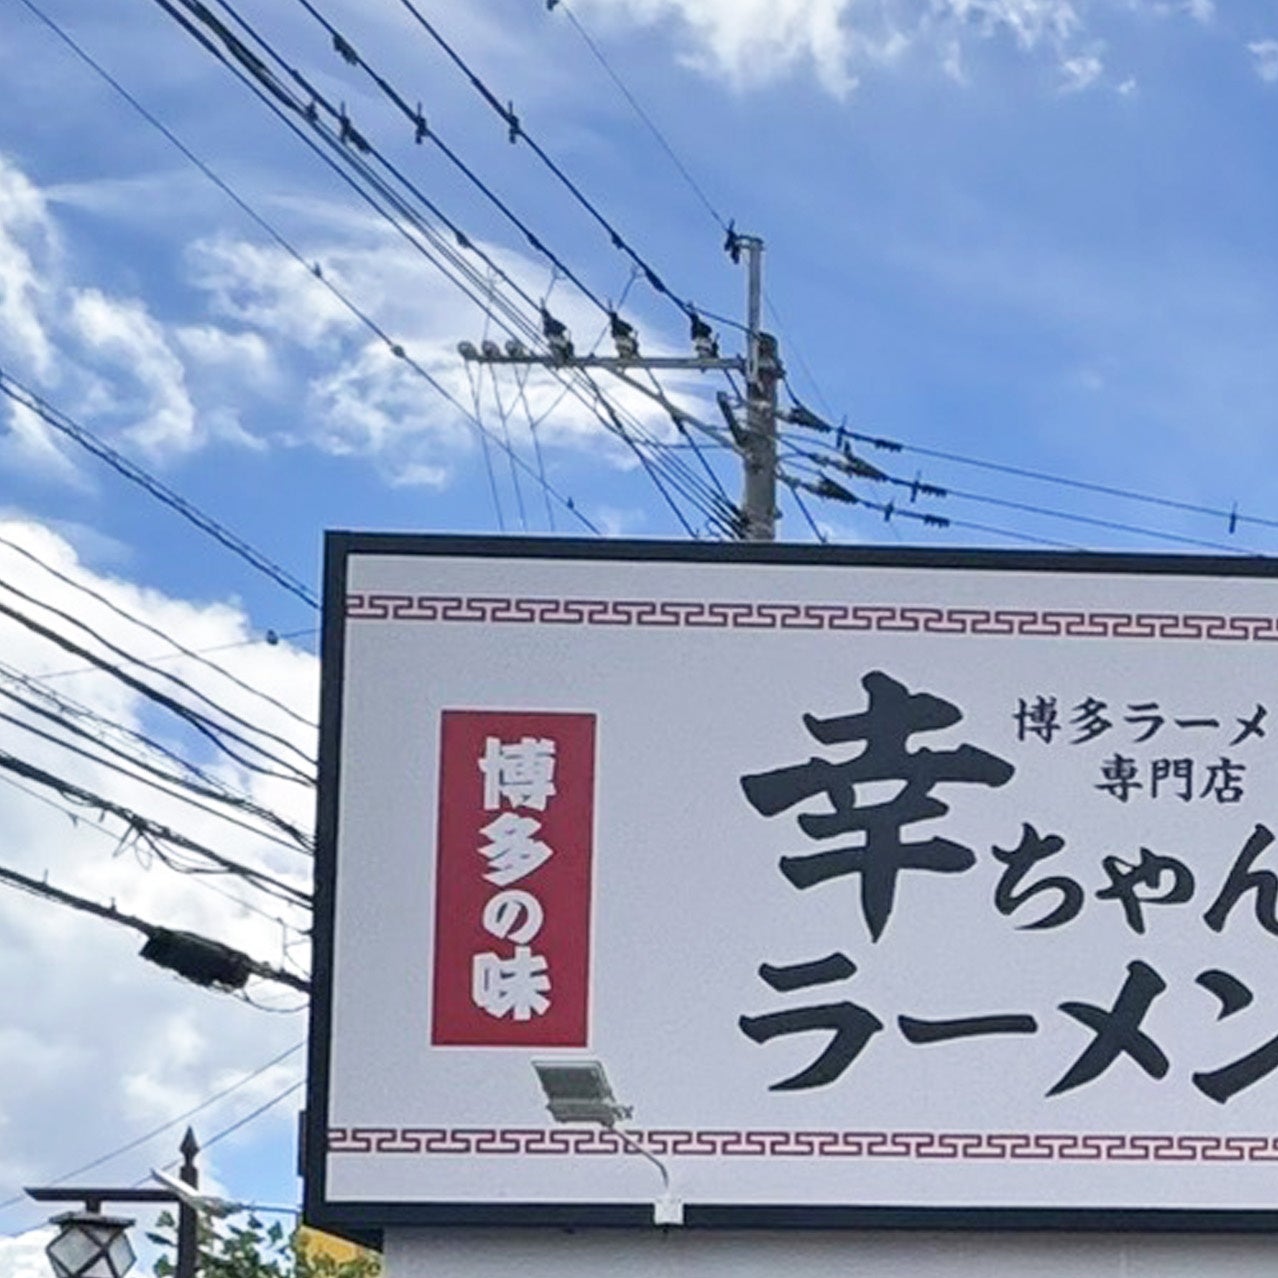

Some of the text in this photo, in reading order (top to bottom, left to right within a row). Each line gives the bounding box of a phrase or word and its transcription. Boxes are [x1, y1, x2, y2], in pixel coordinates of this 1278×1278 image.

[1093, 755, 1248, 805] 専門店
[471, 736, 557, 1021] 博多の味
